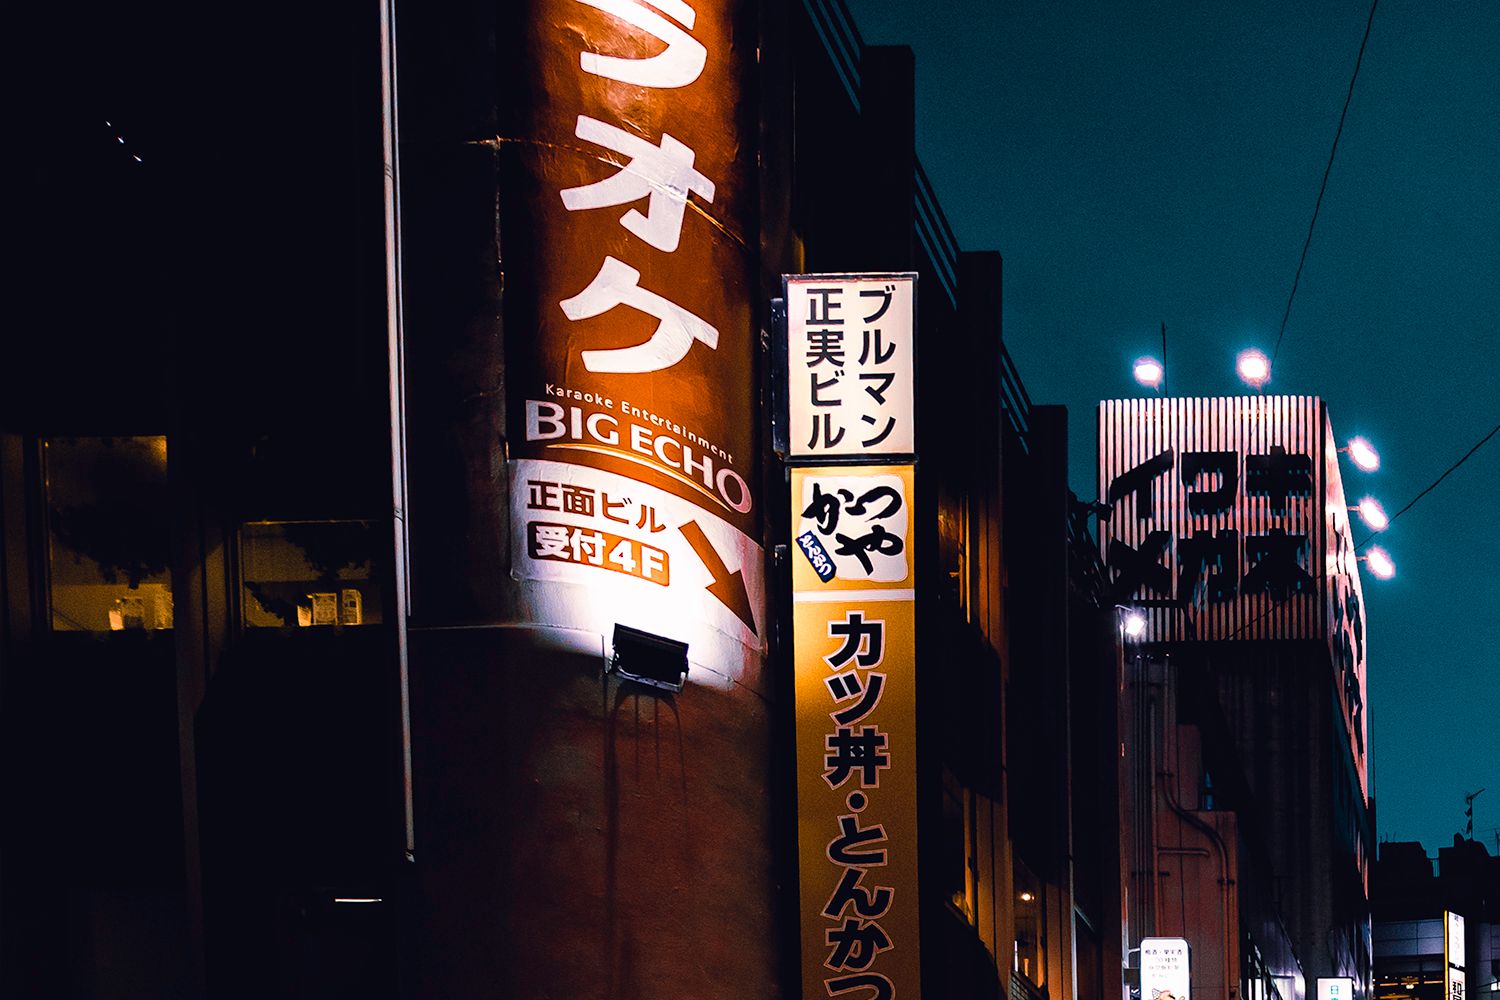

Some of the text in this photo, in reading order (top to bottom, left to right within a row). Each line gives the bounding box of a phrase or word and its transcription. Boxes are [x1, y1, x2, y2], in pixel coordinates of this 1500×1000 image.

[805, 287, 846, 451] 正実ビル
[858, 284, 897, 449] ブルマン
[525, 399, 753, 514] BIG ECHO
[545, 384, 734, 465] Karaoke Entertainment
[527, 479, 667, 534] 正面ビル
[535, 525, 665, 580] 受付4F
[801, 482, 904, 576] かつや
